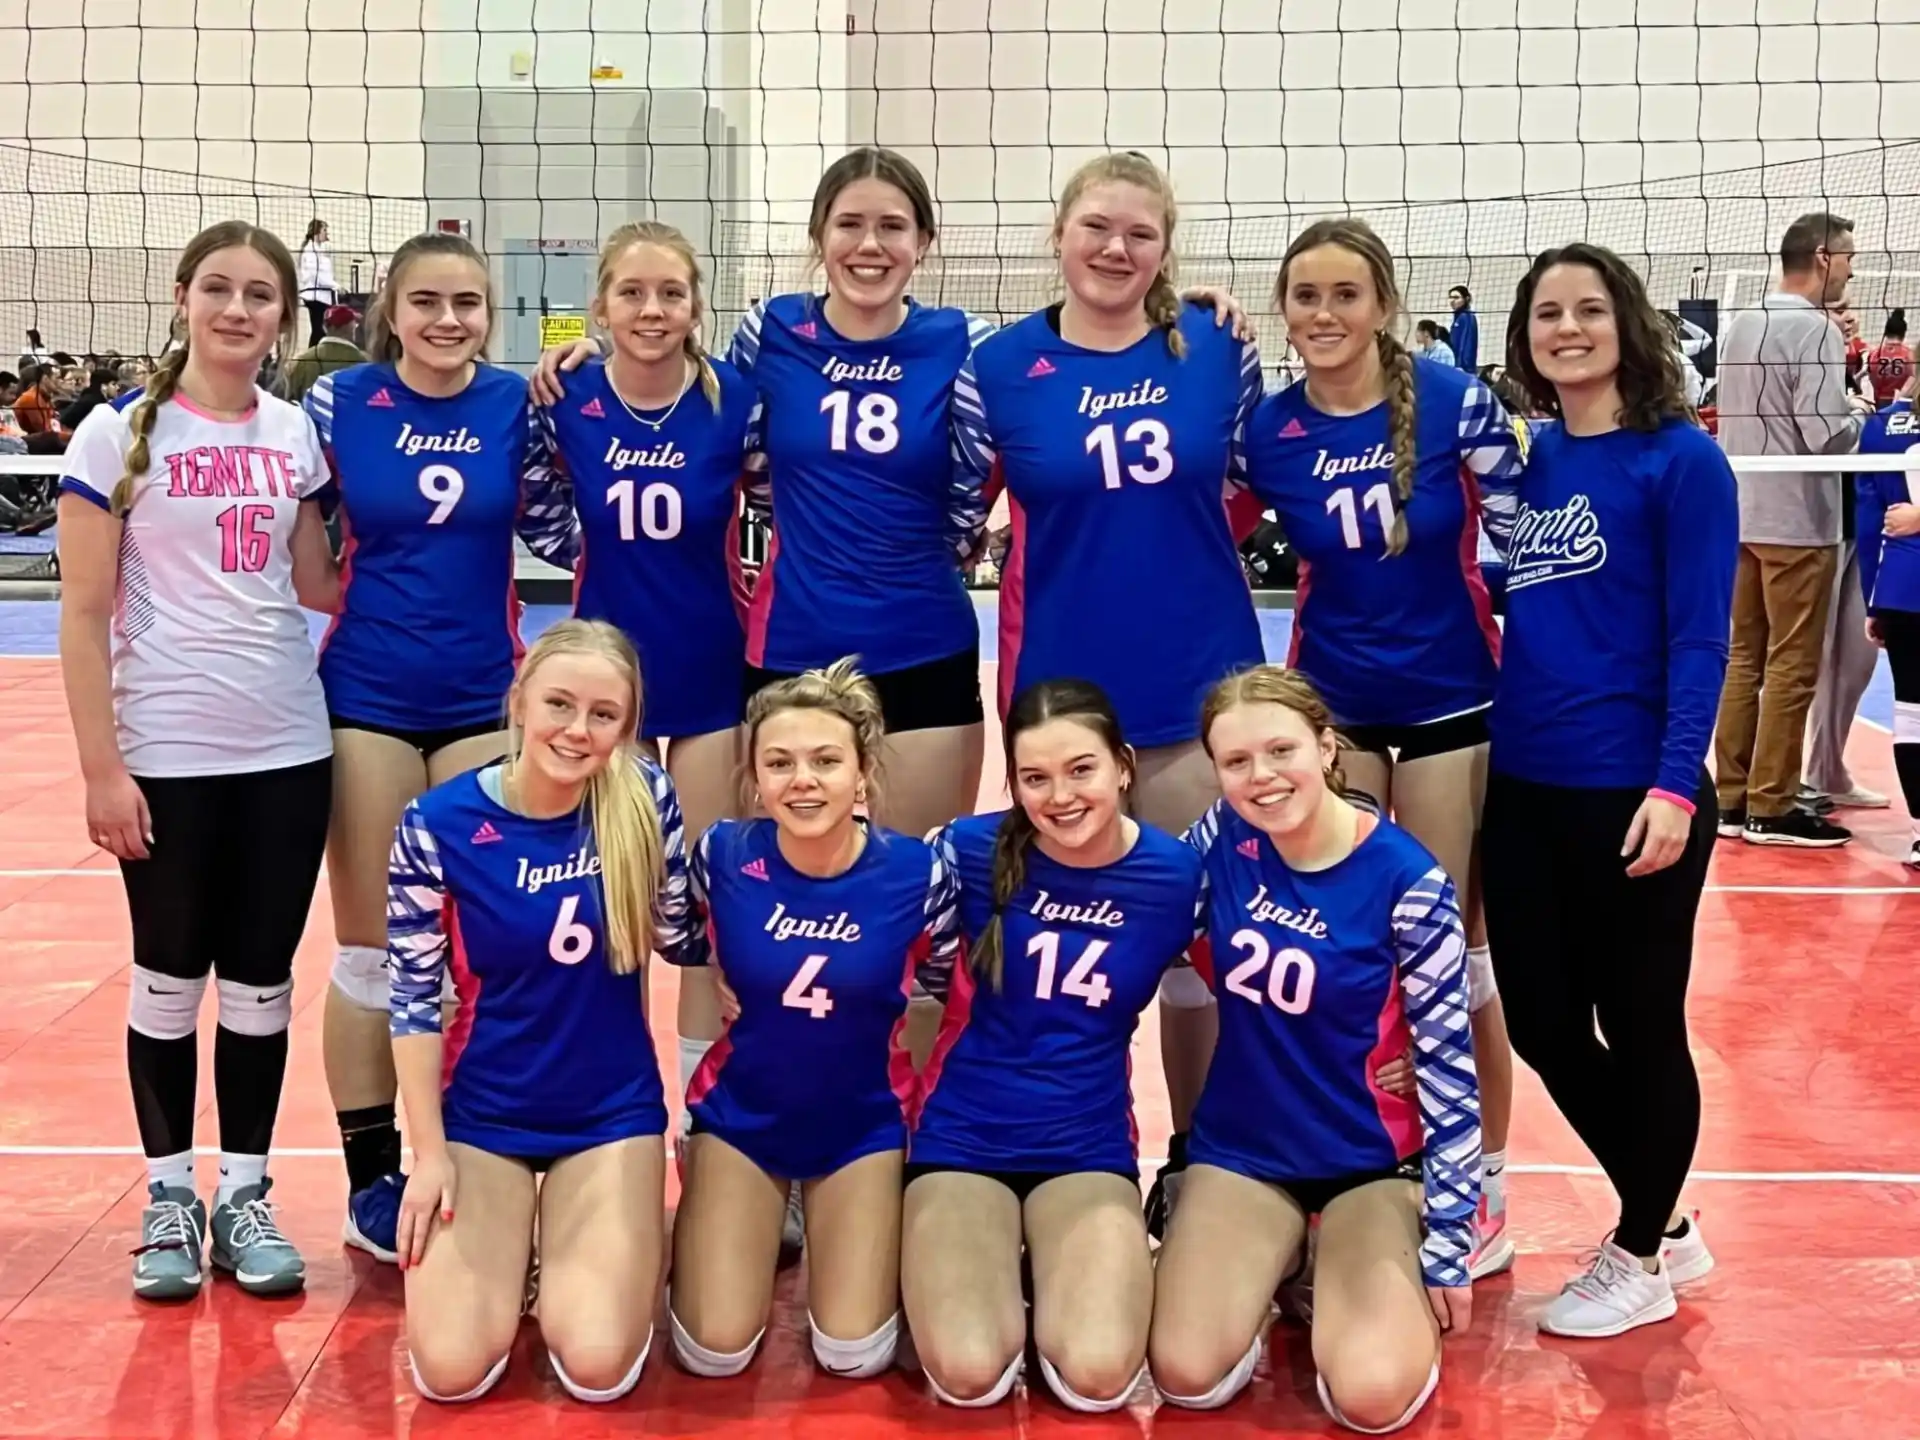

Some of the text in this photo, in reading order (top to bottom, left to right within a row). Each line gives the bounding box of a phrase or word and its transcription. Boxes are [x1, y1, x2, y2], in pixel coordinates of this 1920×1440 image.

[822, 355, 903, 382] Ignite
[820, 390, 899, 454] 18
[1078, 378, 1168, 418] Ignite
[395, 422, 482, 456] Ignite
[604, 436, 686, 471] Ignite
[1085, 418, 1173, 489] 13
[1312, 443, 1396, 481] Ignite
[164, 446, 299, 498] IGNITE
[418, 464, 464, 525] 9
[216, 504, 274, 573] 16
[606, 480, 682, 541] 10
[1326, 483, 1396, 549] 11
[516, 847, 602, 894] Ignite
[548, 894, 593, 965] 6
[764, 902, 861, 942] Ignite
[1030, 889, 1125, 927] Ignite
[1245, 884, 1328, 939] Ignite
[782, 954, 834, 1019] 4
[1025, 931, 1112, 1008] 14
[1225, 929, 1316, 1015] 20
